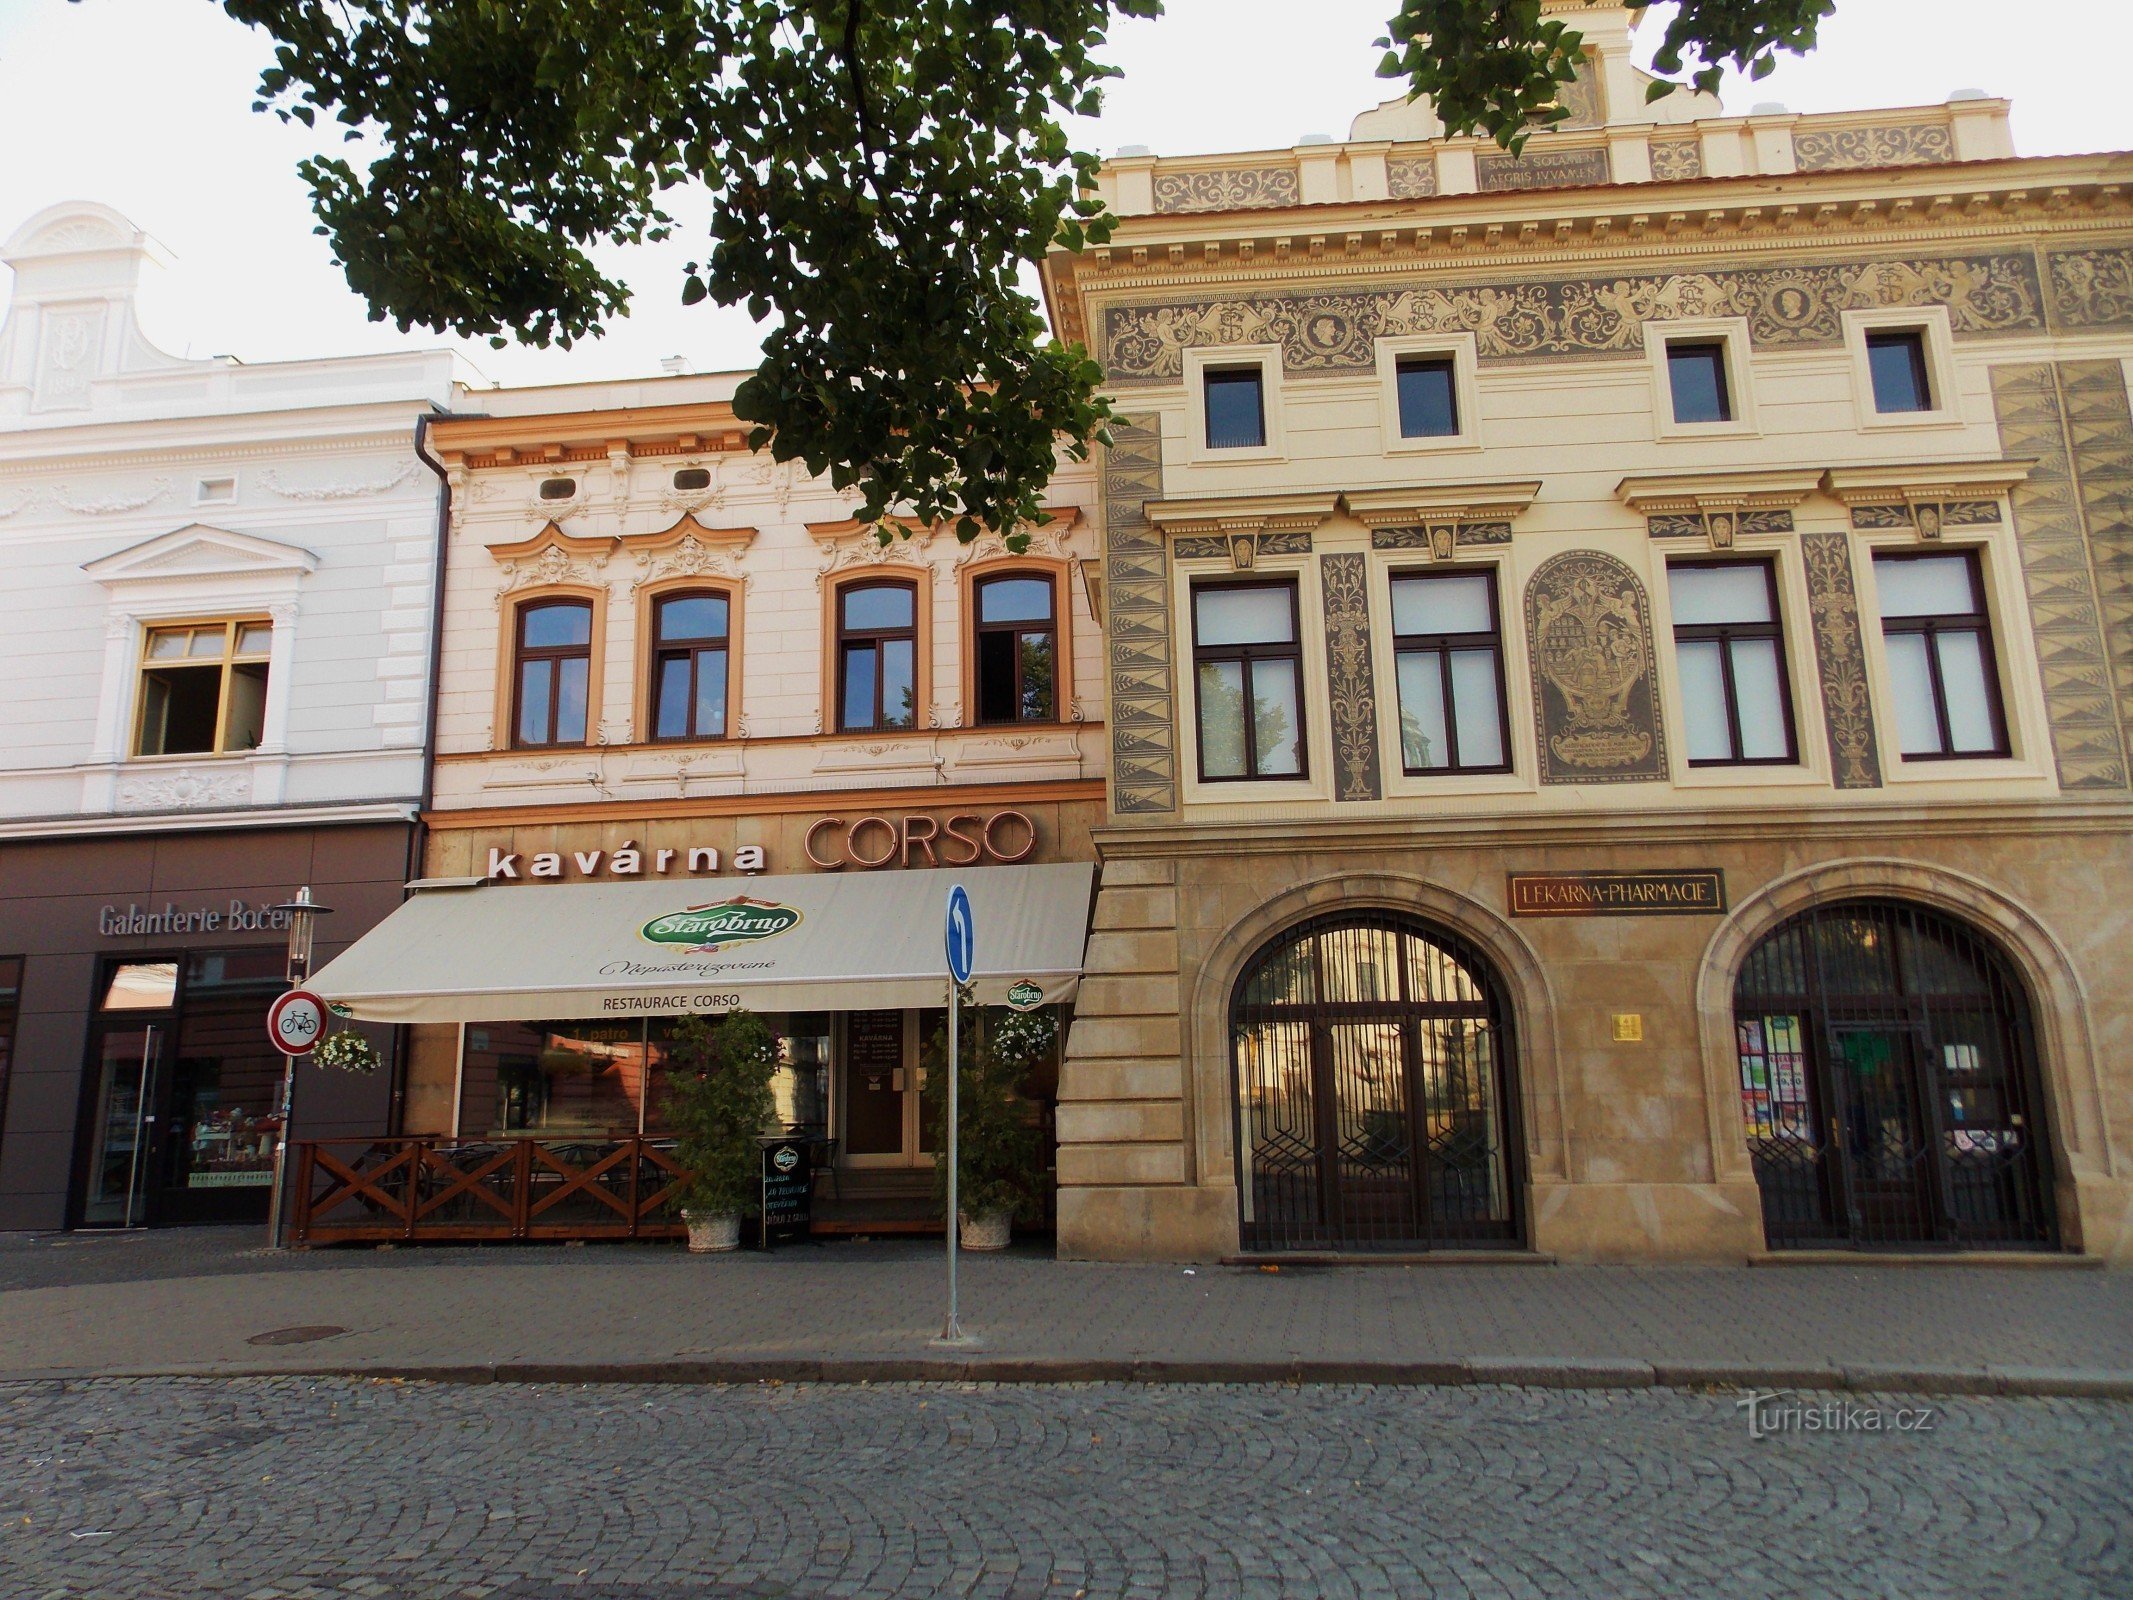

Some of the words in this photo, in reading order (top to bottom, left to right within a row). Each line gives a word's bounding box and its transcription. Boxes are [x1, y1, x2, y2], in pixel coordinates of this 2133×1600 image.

[1488, 157, 1527, 170] SANIS
[1533, 153, 1595, 168] SOLAMEN
[1488, 171, 1531, 184] AEGRIS
[1536, 166, 1597, 181] IVVAMEN
[488, 840, 768, 879] kavárna
[804, 810, 1036, 869] CORSO
[100, 902, 219, 936] Galanterie
[653, 911, 789, 938] Starobrno
[599, 960, 775, 977] Nepasterizované
[603, 996, 687, 1010] RESTAURACE
[694, 994, 740, 1008] CORSO
[1010, 988, 1042, 1003] Starobrno
